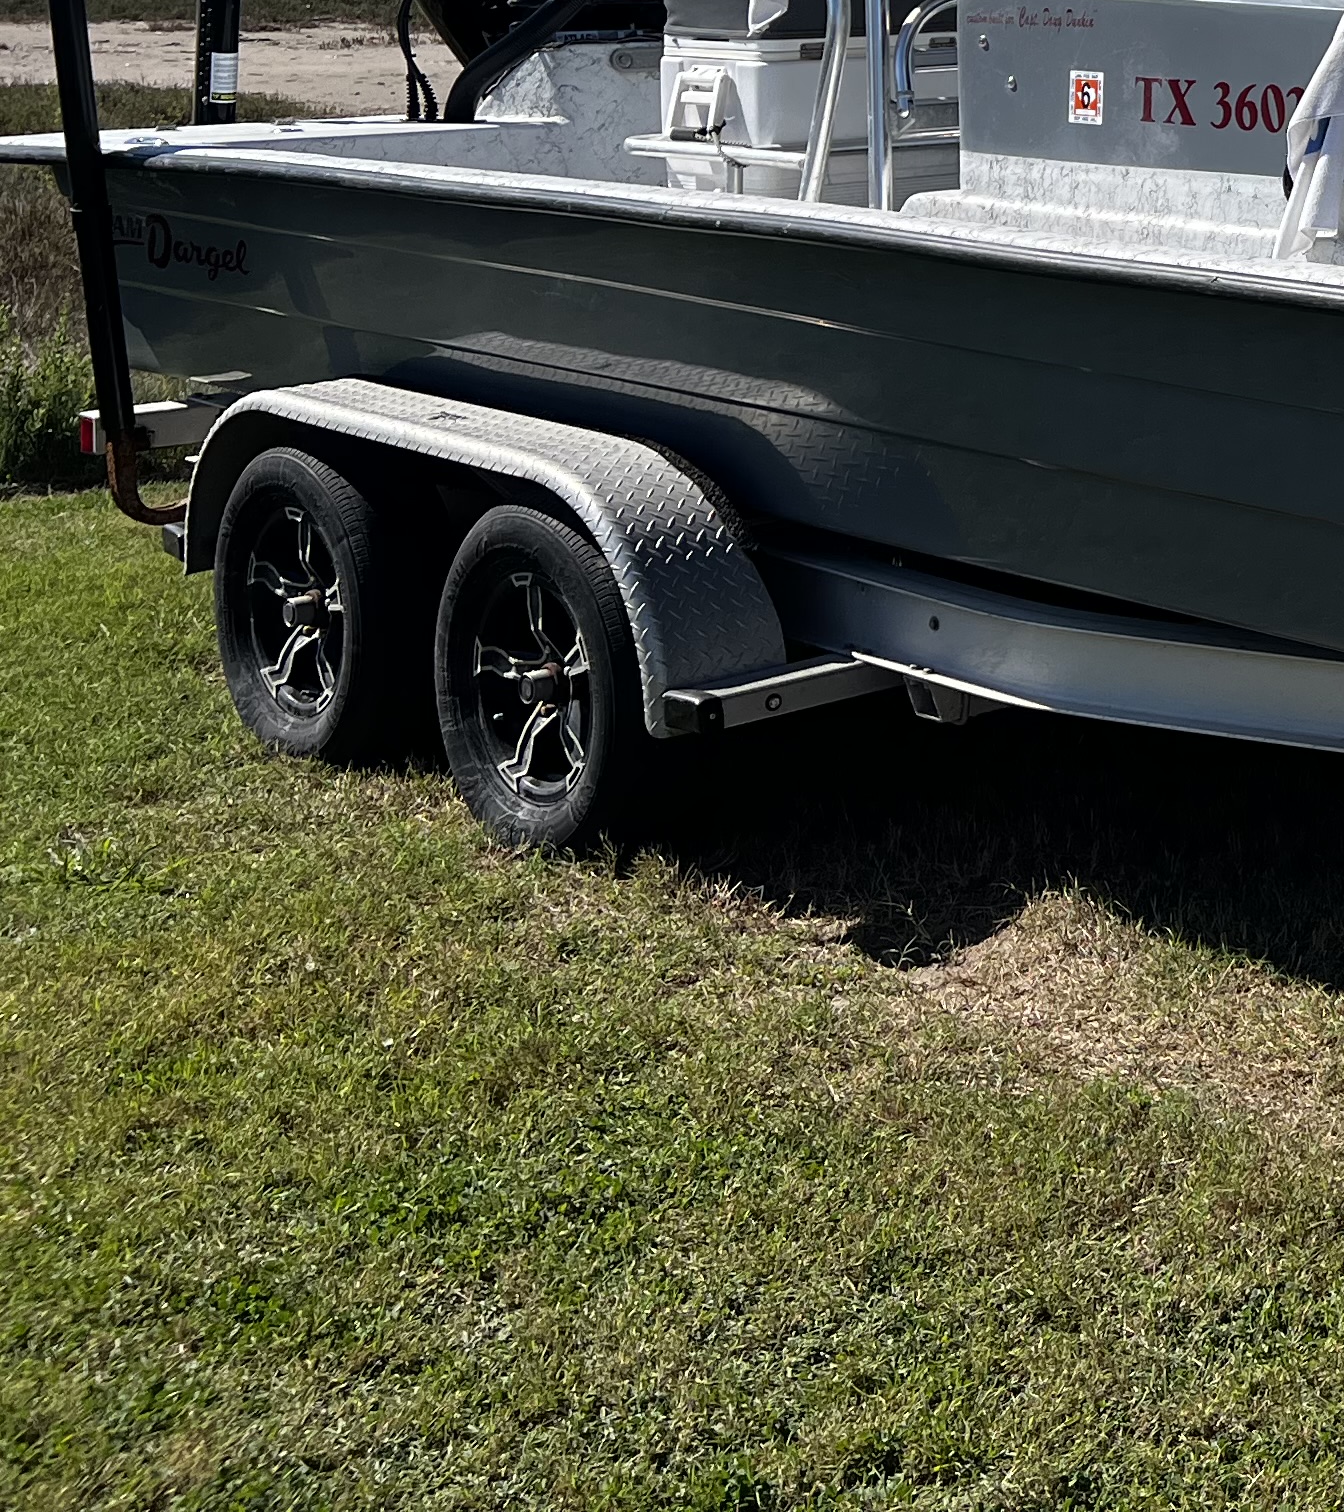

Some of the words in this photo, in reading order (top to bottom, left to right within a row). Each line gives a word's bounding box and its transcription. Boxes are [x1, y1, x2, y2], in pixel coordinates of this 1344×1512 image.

[1081, 81, 1091, 109] 6
[1135, 76, 1197, 127] TX
[145, 213, 250, 281] Dargel
